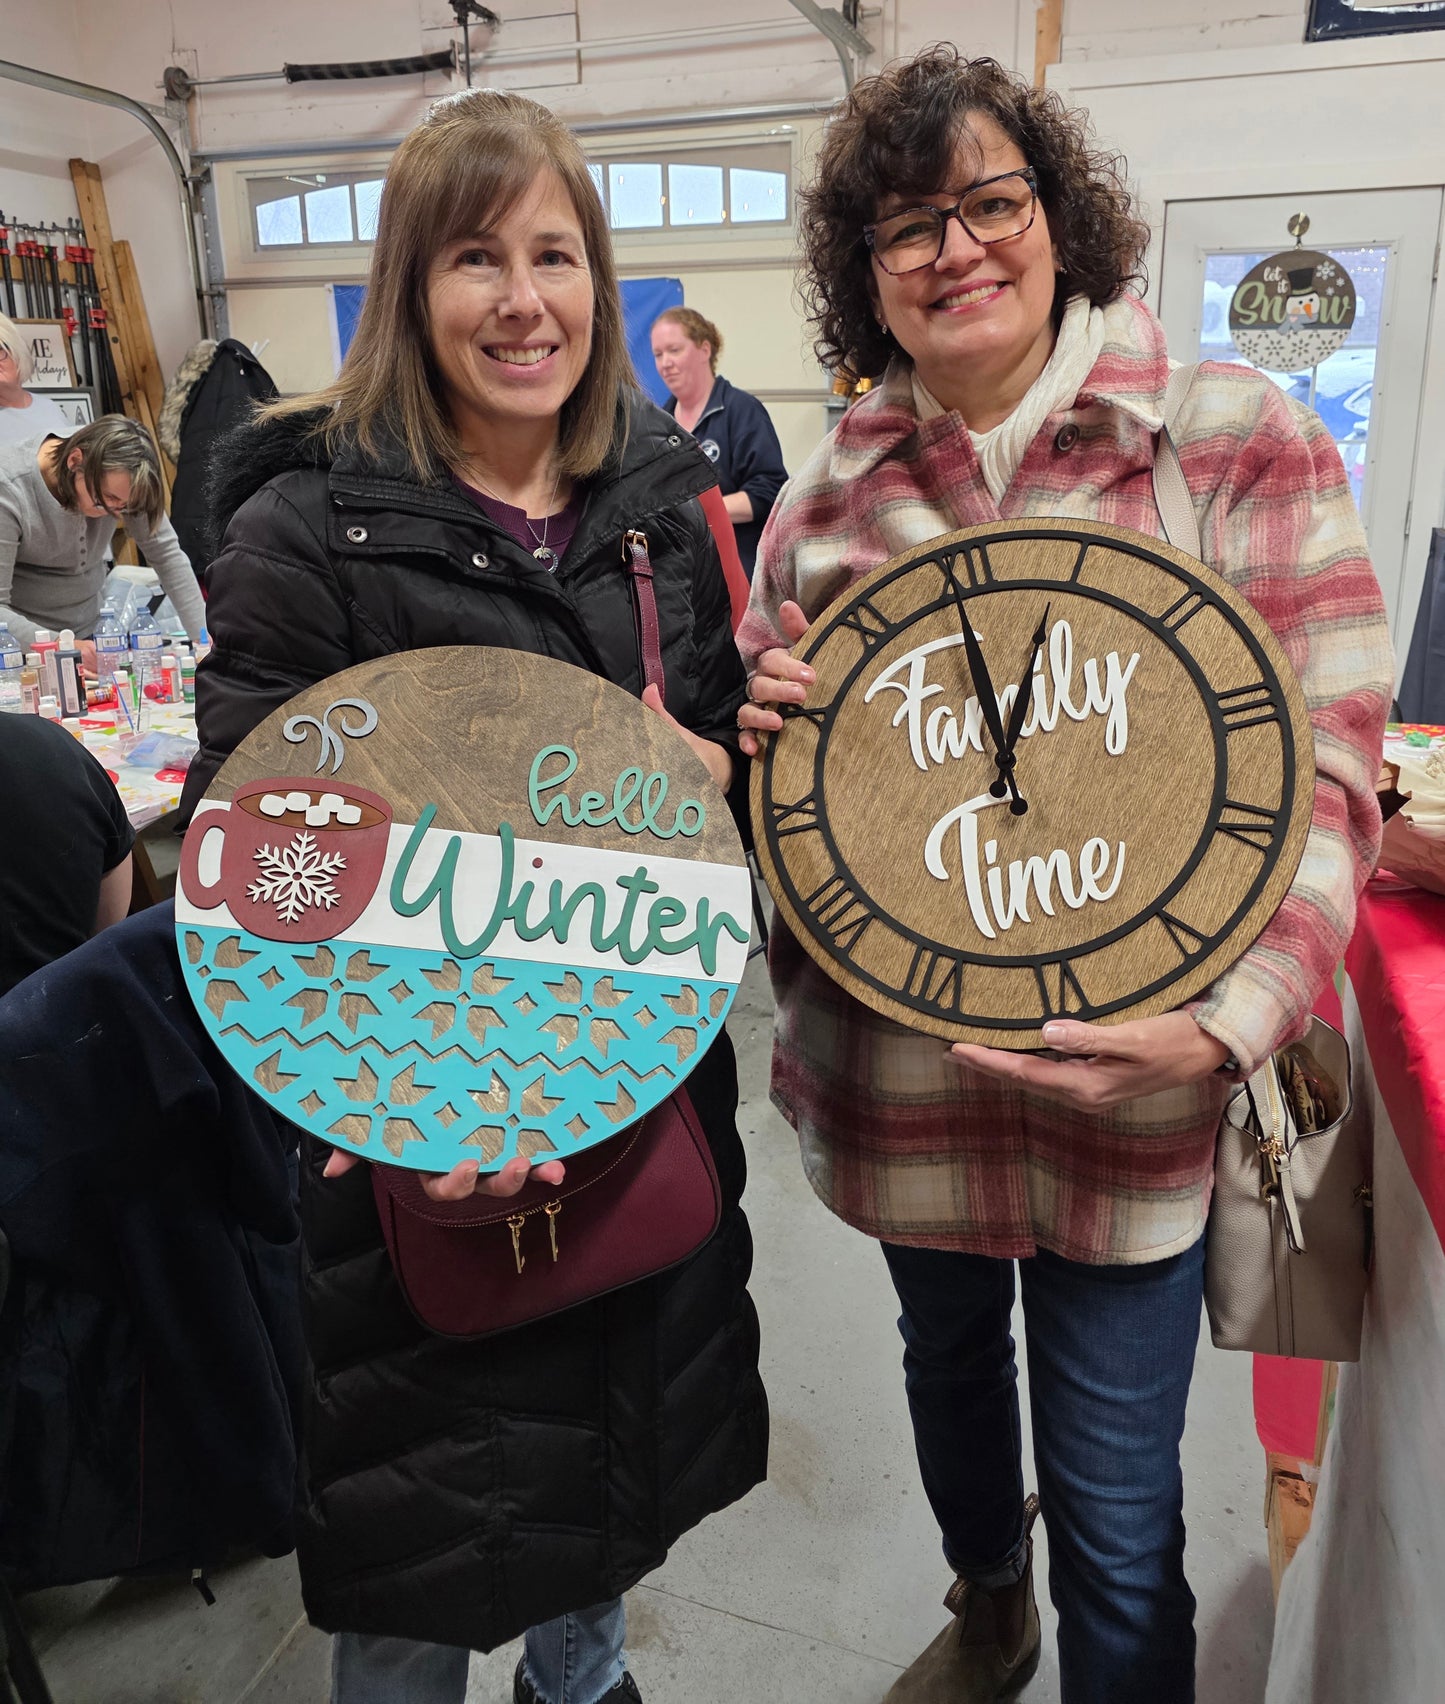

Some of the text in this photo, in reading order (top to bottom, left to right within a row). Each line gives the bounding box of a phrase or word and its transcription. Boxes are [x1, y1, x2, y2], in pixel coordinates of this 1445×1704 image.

[1233, 280, 1351, 325] Snw
[1263, 265, 1282, 281] let
[1277, 278, 1289, 294] it
[528, 743, 706, 840] hello
[389, 802, 751, 976] Winter
[924, 785, 1126, 941] Time
